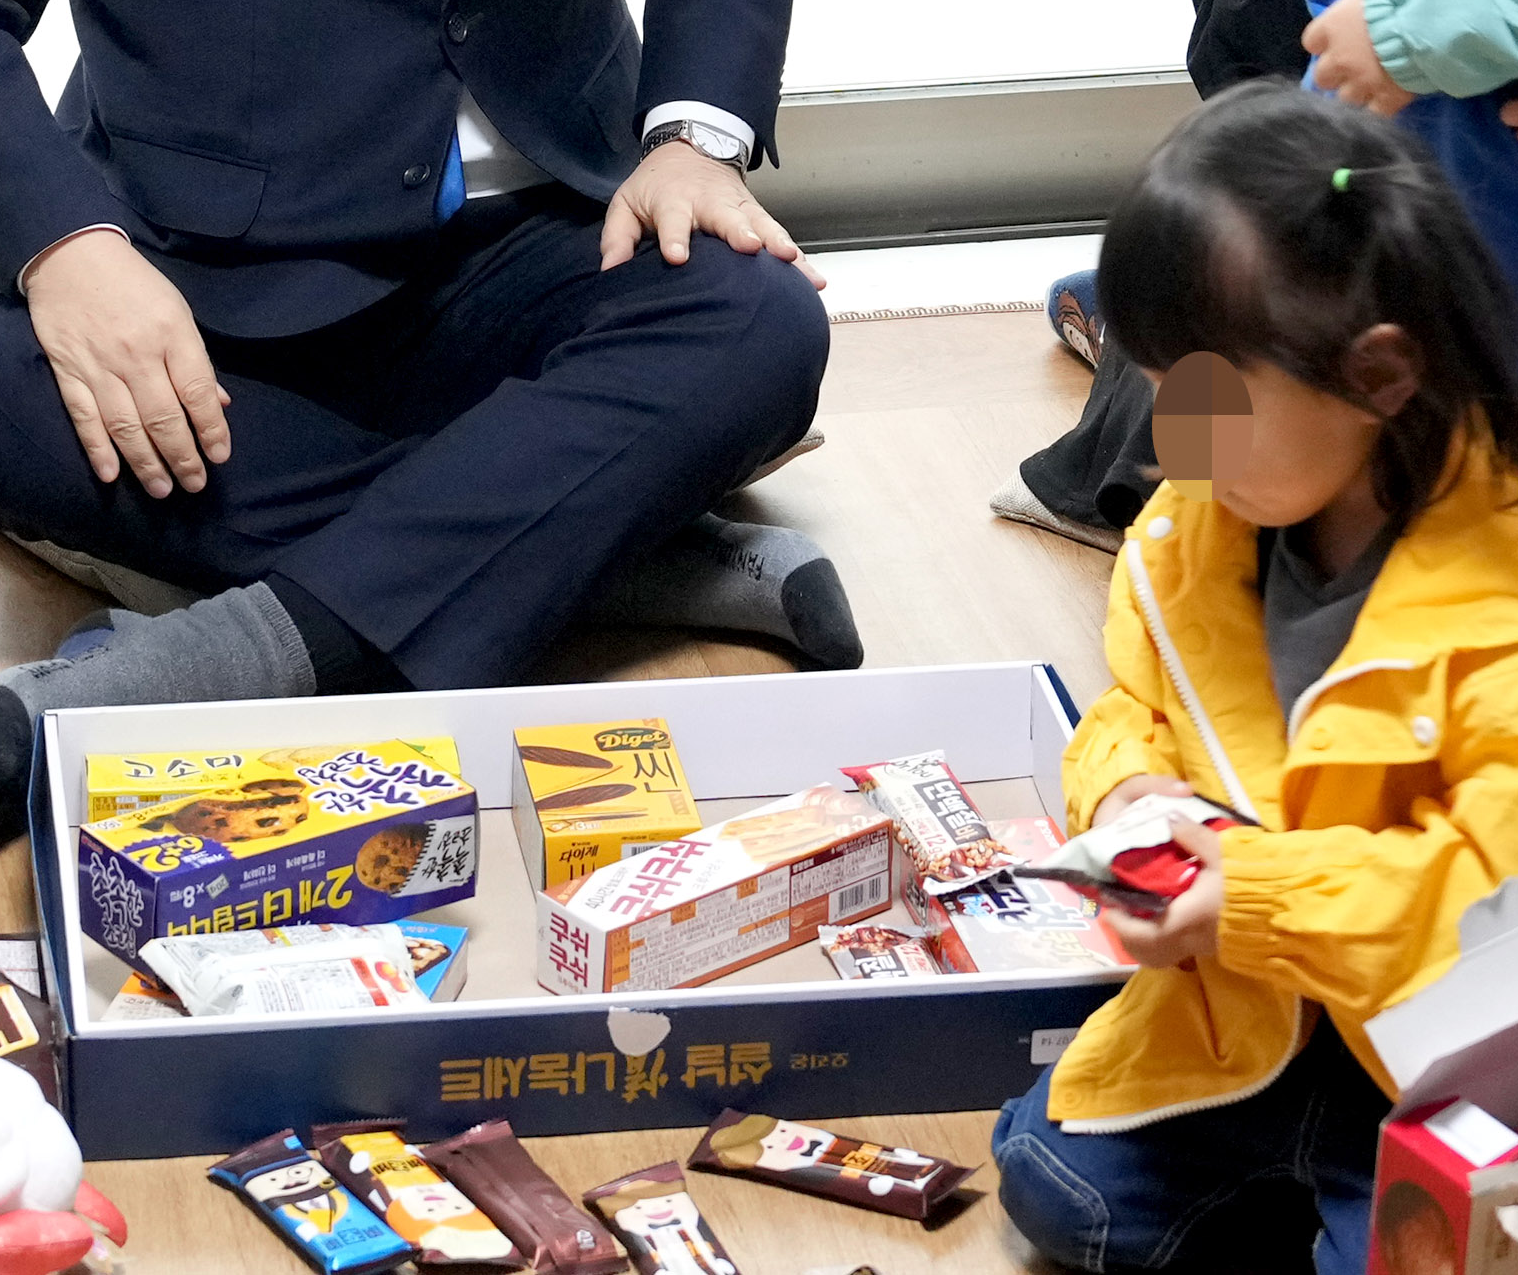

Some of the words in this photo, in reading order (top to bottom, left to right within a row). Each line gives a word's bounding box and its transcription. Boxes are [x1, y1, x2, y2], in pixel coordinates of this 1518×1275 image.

[598, 729, 667, 750] Diget
[124, 754, 243, 779] 고소미
[633, 751, 682, 793] 씬
[559, 844, 600, 864] 다이제
[262, 888, 293, 926] 더
[299, 864, 355, 915] 2개
[681, 1041, 774, 1089] 설날
